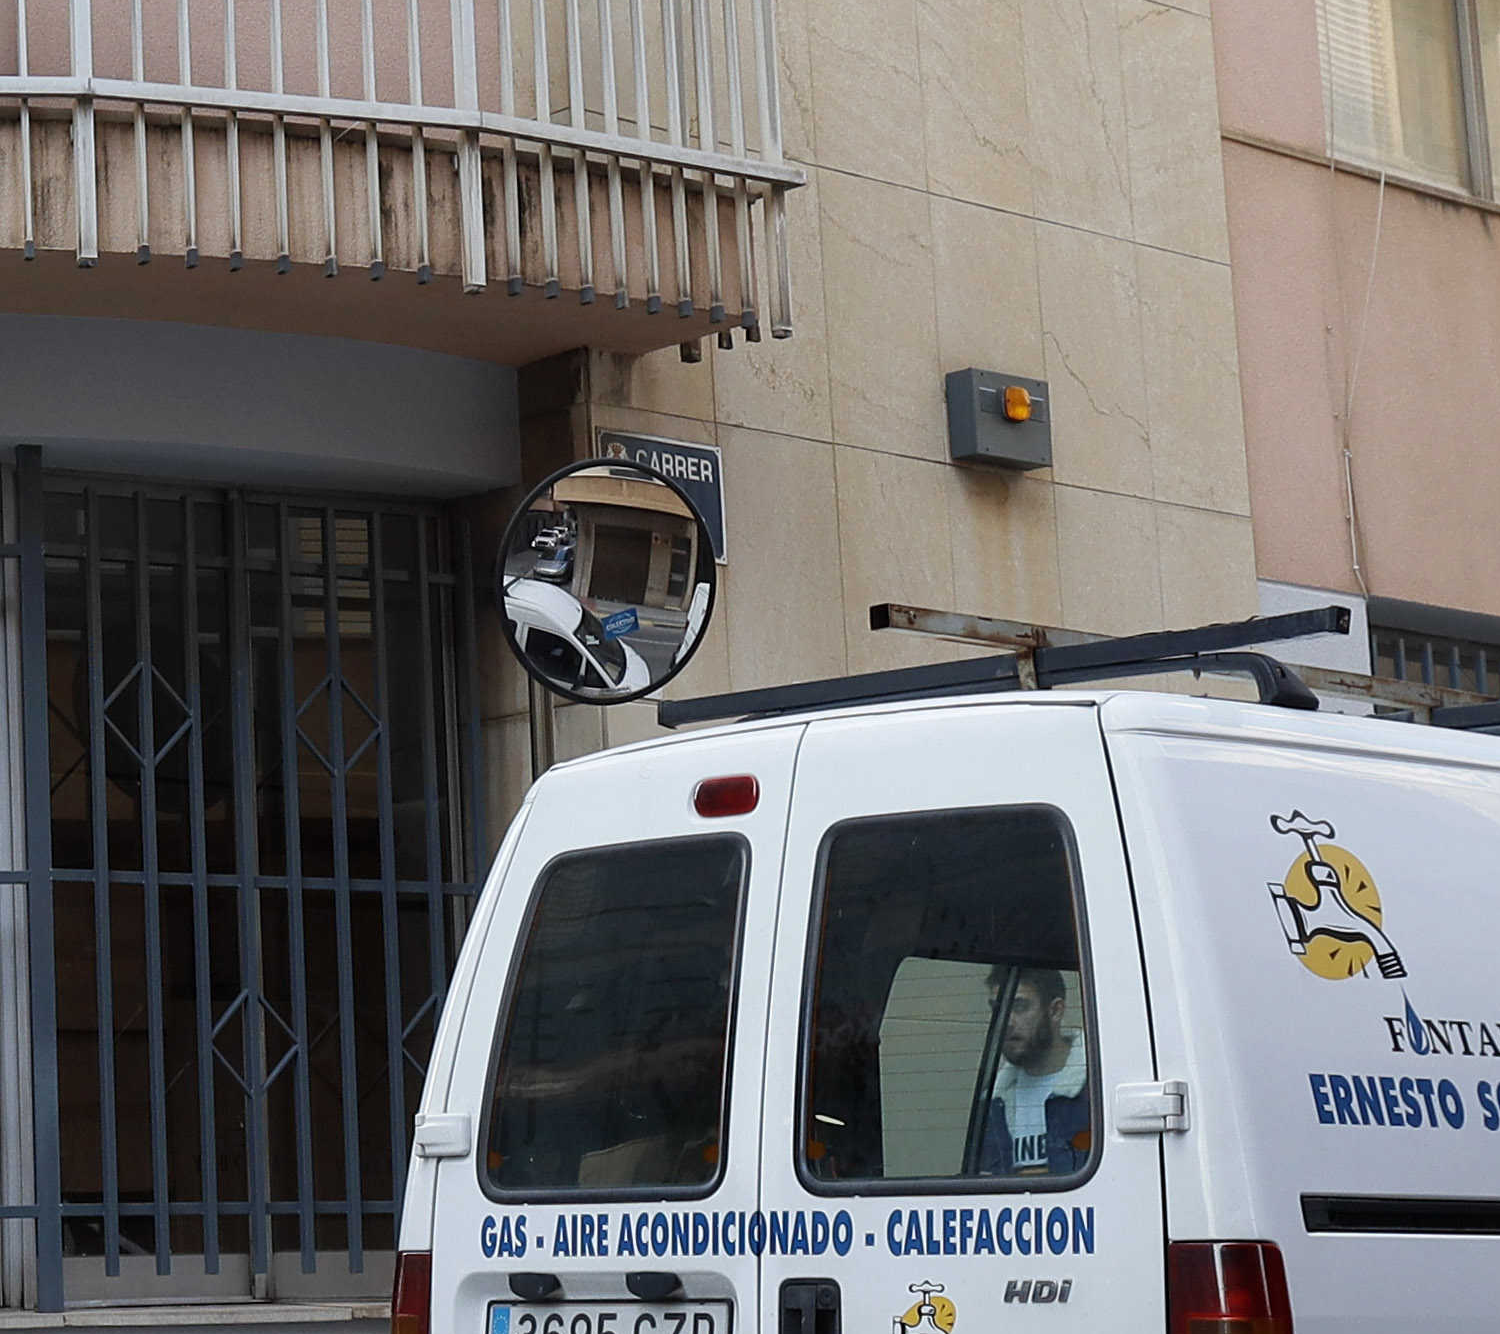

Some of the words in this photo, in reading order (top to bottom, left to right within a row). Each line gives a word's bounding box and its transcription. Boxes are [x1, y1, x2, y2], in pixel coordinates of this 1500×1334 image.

[1308, 1073, 1465, 1130] ERNESTO
[481, 1214, 528, 1258] GAS
[553, 1214, 609, 1257] AIRE
[616, 1210, 853, 1257] ACONDICIONADO
[887, 1207, 1095, 1257] CALEFACCION
